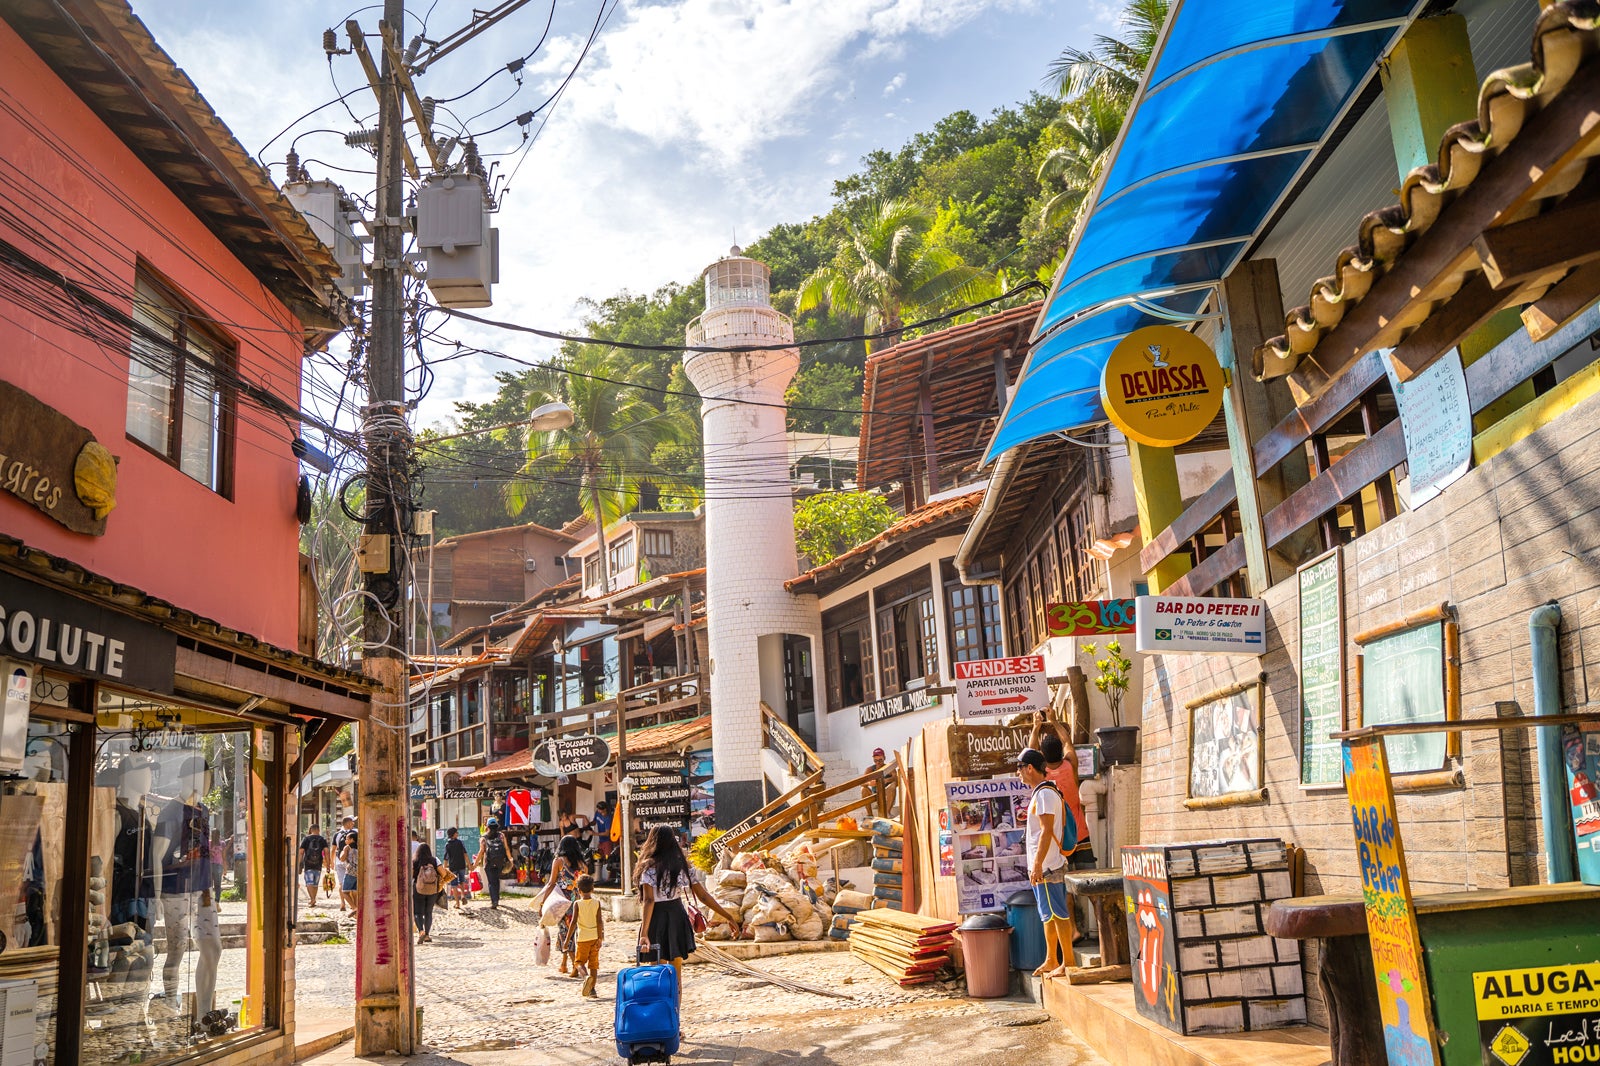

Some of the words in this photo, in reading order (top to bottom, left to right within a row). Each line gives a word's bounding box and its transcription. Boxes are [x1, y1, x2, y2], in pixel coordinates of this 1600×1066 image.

[1120, 364, 1207, 398] DEVASSA
[1156, 602, 1183, 614] BAR
[1186, 603, 1205, 614] DO
[1207, 604, 1249, 616] PETER
[1251, 605, 1260, 616] II
[1174, 617, 1184, 626] De
[1186, 618, 1207, 627] Peter
[1208, 619, 1216, 627] &
[1217, 619, 1242, 628] Gaston
[961, 657, 1040, 677] VENDE-SE
[966, 675, 1036, 689] APARTAMENTOS
[7, 688, 29, 702] GREE
[1010, 686, 1033, 694] PRAIA.
[860, 701, 887, 723] POUSADA
[557, 739, 593, 749] Pousada
[967, 729, 1012, 753] Pousada
[560, 747, 594, 759] FAROL
[626, 760, 649, 770] PISCINA
[640, 776, 682, 785] CONDICIONADO
[445, 787, 484, 799] Pizzeria
[628, 792, 658, 801] ASCENSOR
[660, 789, 689, 799] INCLINADO
[950, 782, 1007, 796] POUSADA
[636, 805, 685, 816] RESTAURANTE
[1352, 805, 1382, 849] BAR
[1121, 853, 1134, 876] BAR
[1141, 852, 1167, 879] PETER
[1360, 842, 1400, 894] Peter
[983, 897, 993, 905] 9.0
[1482, 969, 1600, 1000] ALUGA-
[1501, 1003, 1542, 1015] DIARIA
[1546, 1002, 1554, 1011] E
[1557, 999, 1600, 1010] TEMPO
[1544, 1018, 1590, 1047] Local
